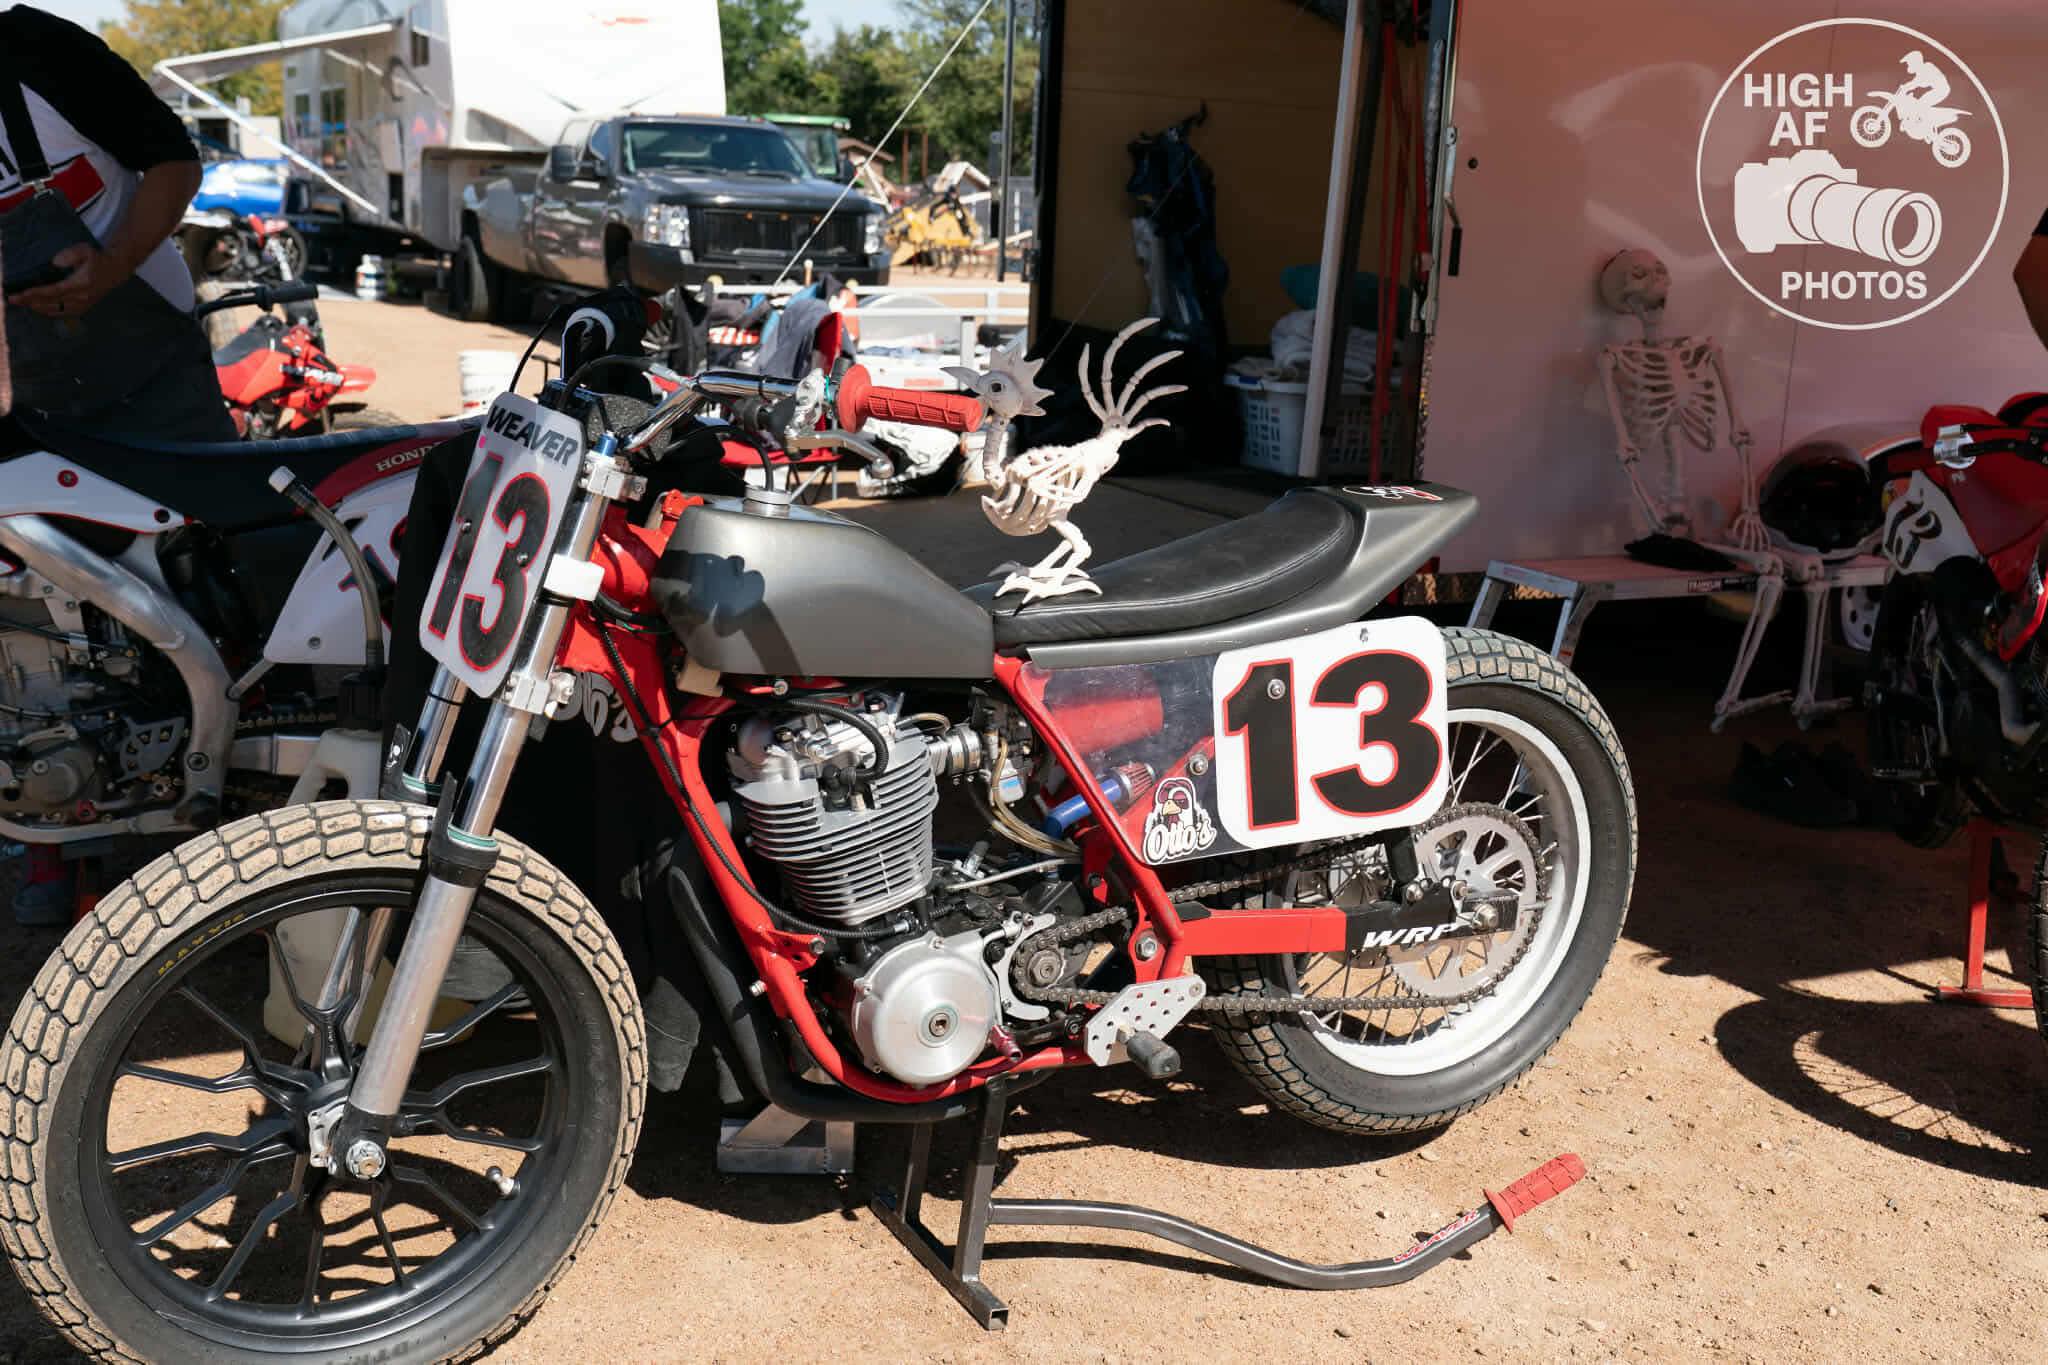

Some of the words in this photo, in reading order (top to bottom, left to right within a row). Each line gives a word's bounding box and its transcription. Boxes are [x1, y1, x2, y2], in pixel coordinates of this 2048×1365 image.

[486, 404, 578, 467] WEAVER
[427, 450, 551, 673] 13
[1221, 648, 1444, 831] 13
[1145, 819, 1216, 862] Otto's
[1362, 922, 1461, 950] WRP
